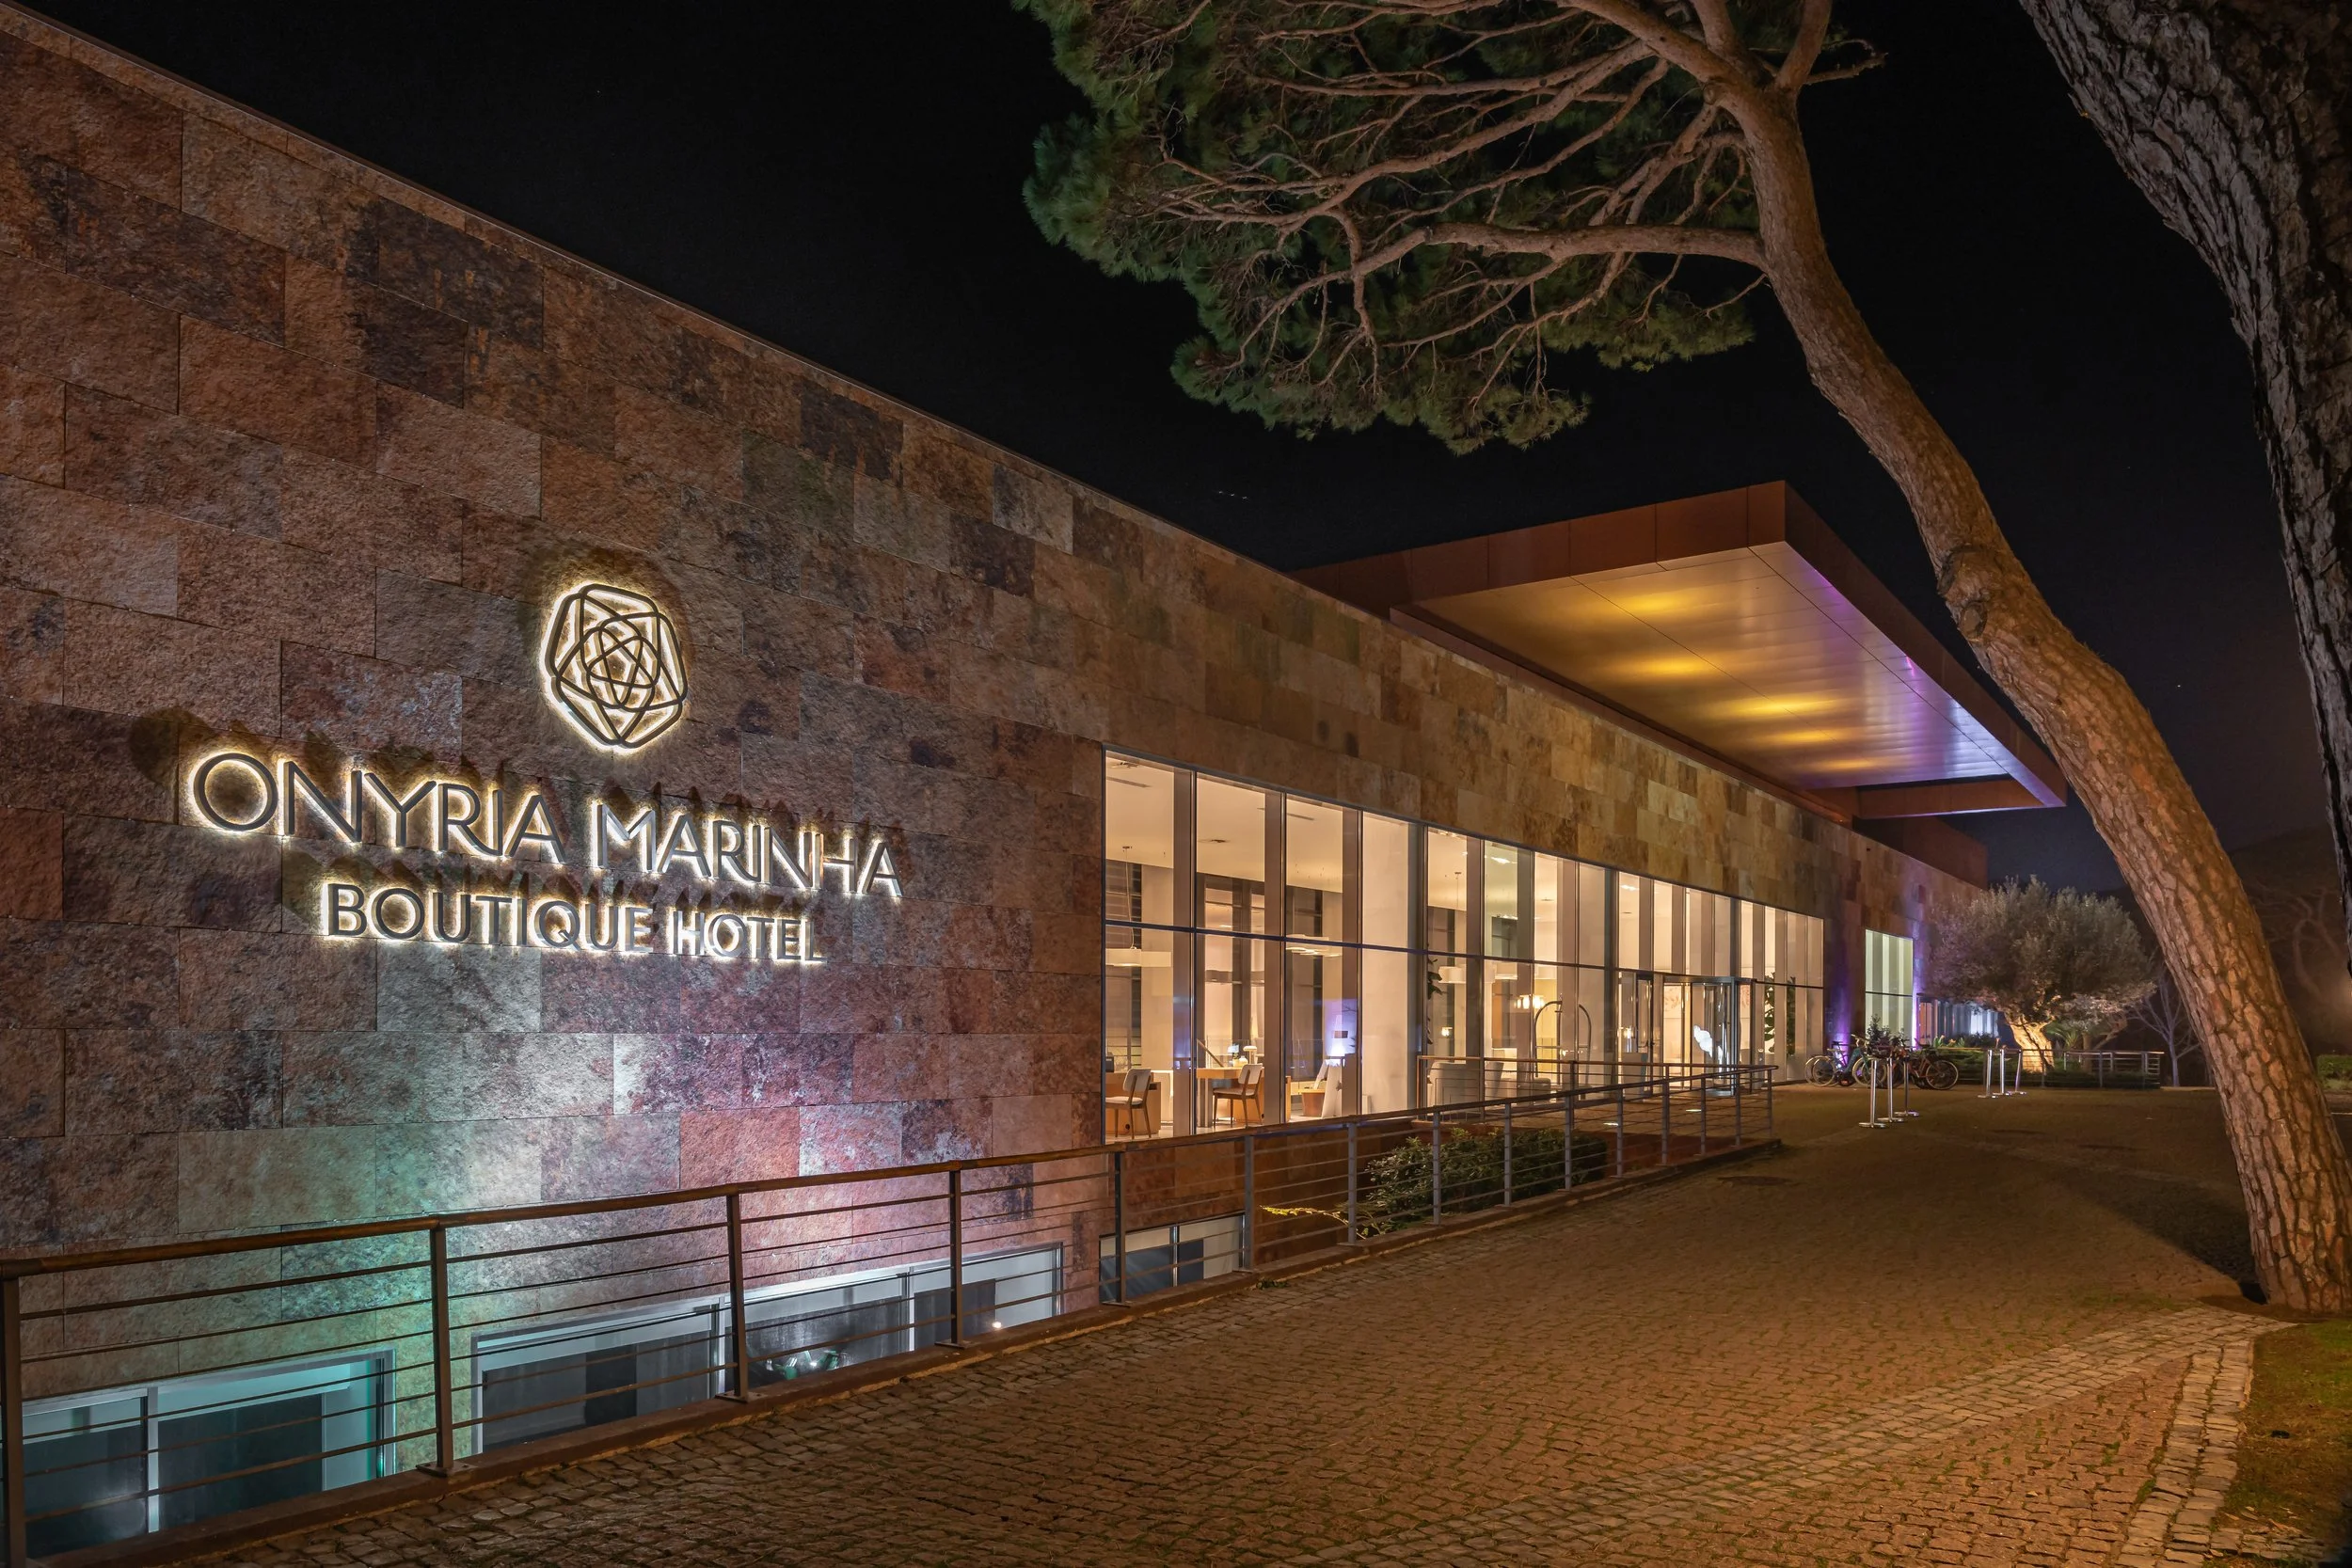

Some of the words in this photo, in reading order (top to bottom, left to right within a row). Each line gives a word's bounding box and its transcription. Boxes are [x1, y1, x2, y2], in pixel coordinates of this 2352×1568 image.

[191, 752, 564, 863] ONYRIA
[593, 800, 904, 897] MARINHA
[326, 882, 653, 953] BOUTIQUE
[672, 909, 826, 963] HOTEL
